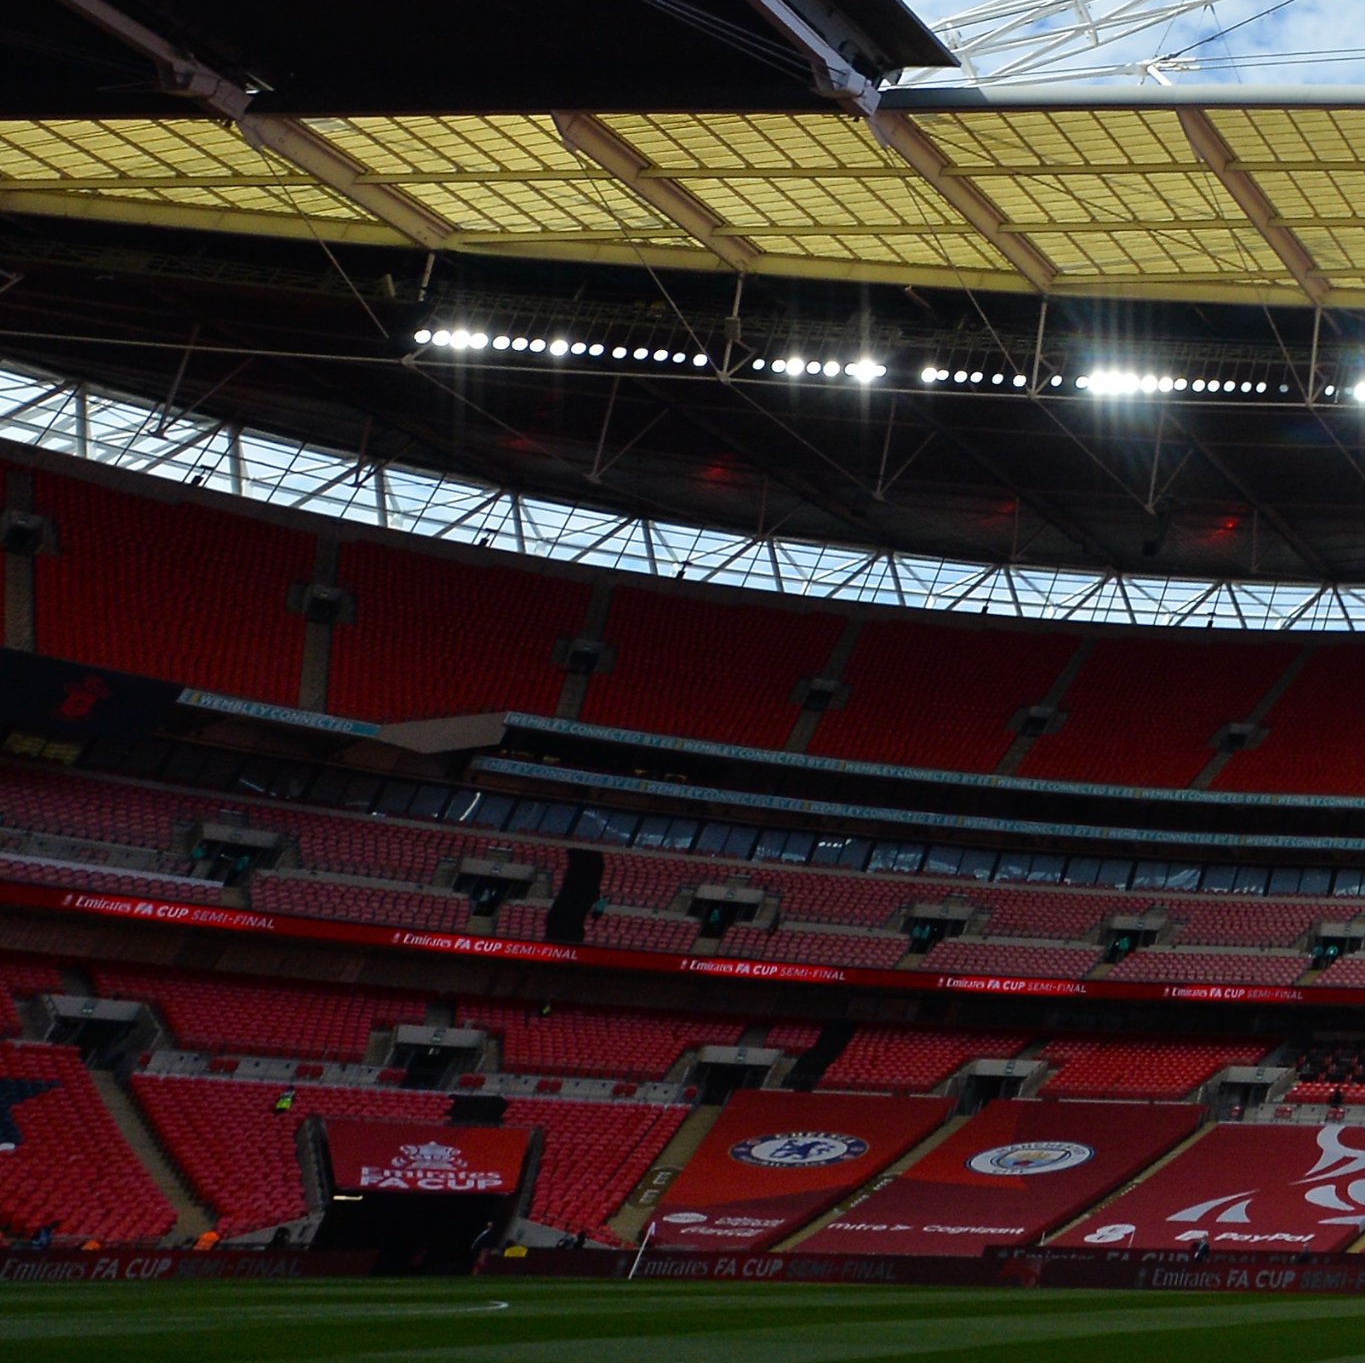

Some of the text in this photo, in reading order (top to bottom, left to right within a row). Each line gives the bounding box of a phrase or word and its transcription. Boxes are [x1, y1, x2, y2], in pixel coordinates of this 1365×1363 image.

[200, 692, 352, 733] WEMBLEY CONNECTED
[510, 714, 673, 749] WEMBLEY CONNECTED BY EE
[75, 893, 274, 930] Emirates FA CUP SEMI-FINAL
[403, 933, 577, 960] Emirates FA CUP SEMI-FINAL
[689, 959, 845, 981] Emirates FA CUP SEMI-FINAL
[946, 978, 1086, 994] Emirates FA CUP SEMI-FINAL
[1172, 987, 1303, 1000] Emirates FA CUP SEMI-FINAL
[360, 1166, 501, 1179] Emirates
[360, 1177, 503, 1189] FA CUP
[828, 1222, 1024, 1235] mitre Cognizant
[1215, 1232, 1316, 1243] PayPal
[1, 1257, 301, 1280] Emirates FA CUP SEMI-FINAL
[713, 1258, 738, 1275] FA
[742, 1258, 784, 1276] CUP
[787, 1260, 898, 1280] SEMI-FINAL
[1153, 1267, 1221, 1288] Emirates
[1226, 1270, 1250, 1288] FA
[1255, 1270, 1296, 1289] CUP
